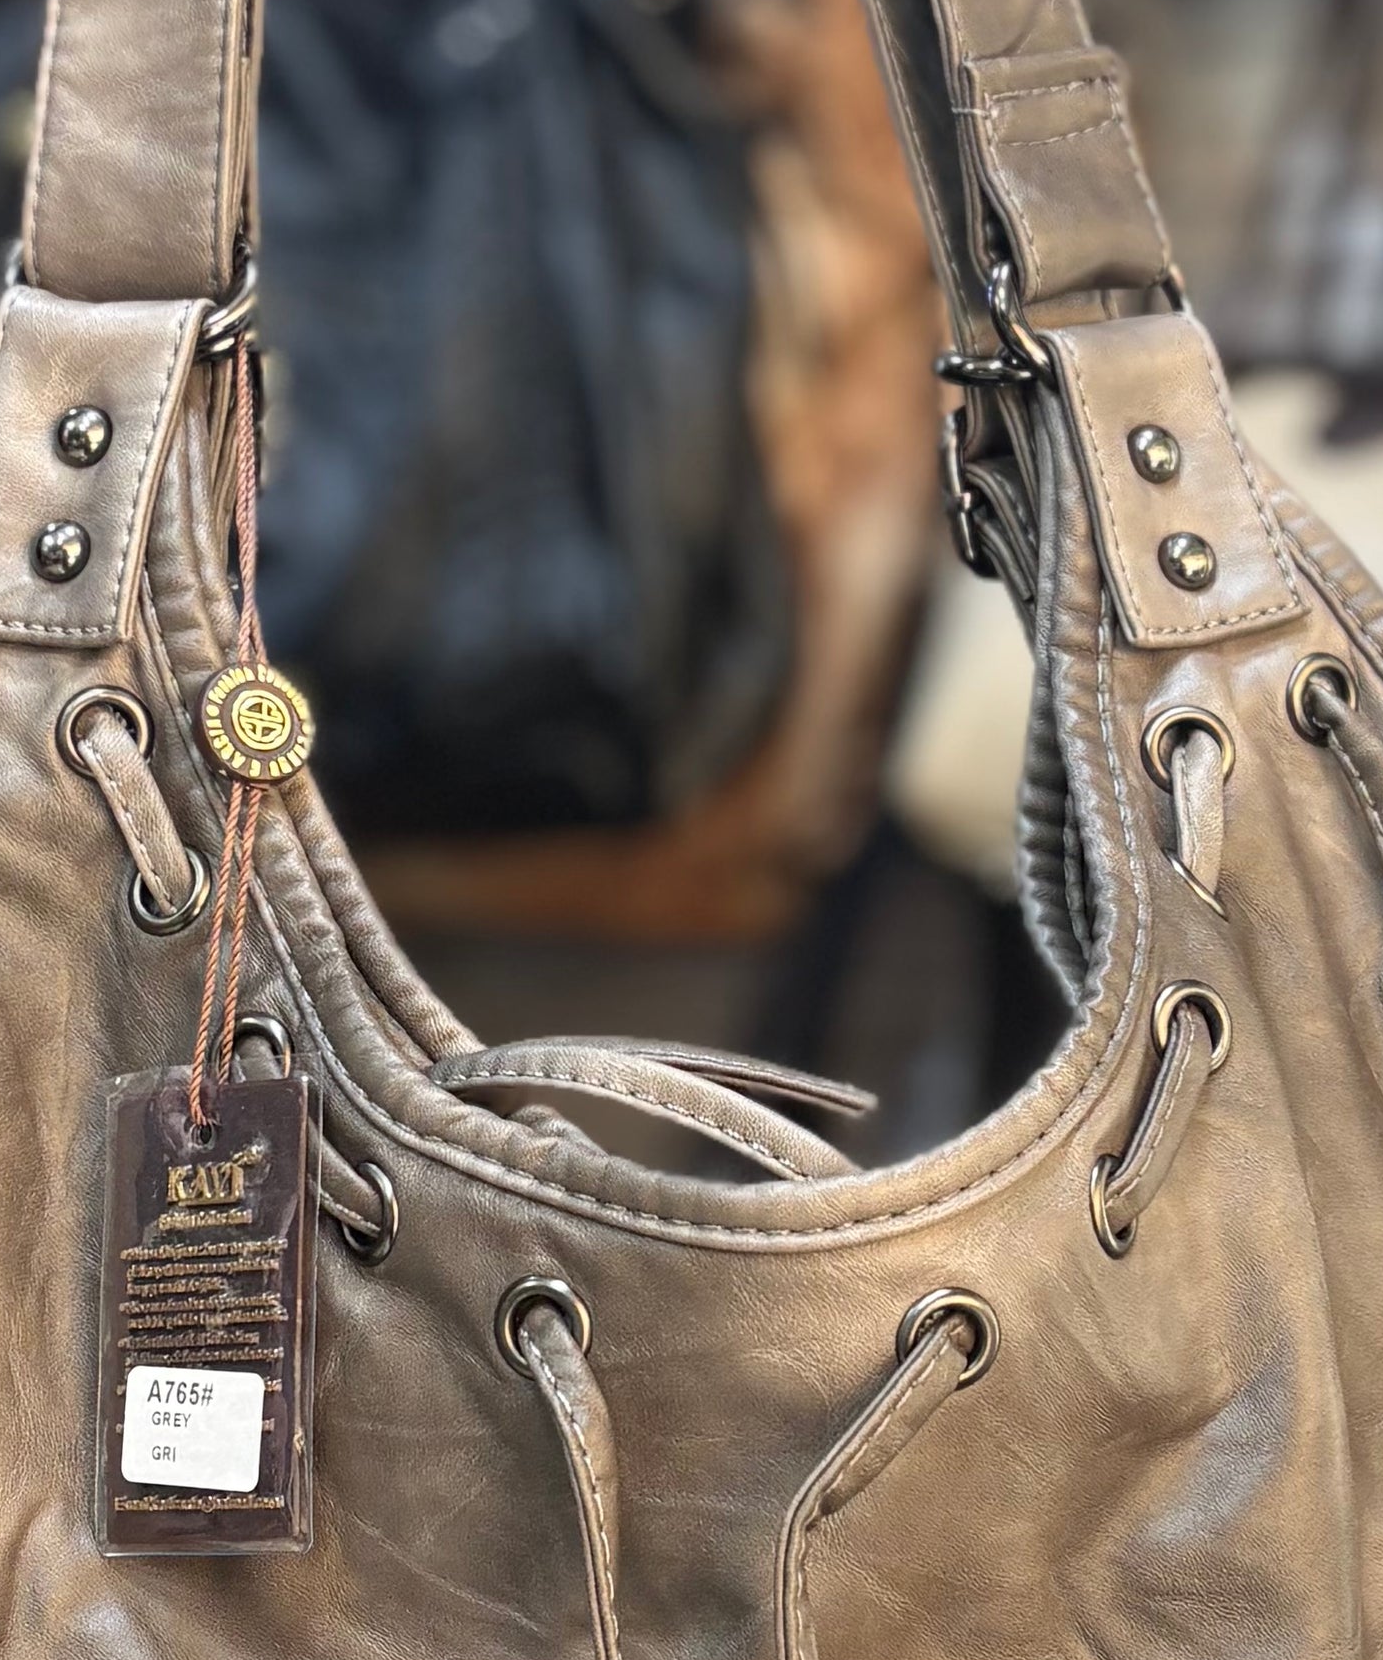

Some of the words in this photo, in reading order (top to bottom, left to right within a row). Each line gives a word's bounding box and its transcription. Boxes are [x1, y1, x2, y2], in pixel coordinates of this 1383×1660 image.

[147, 1379, 215, 1406] A765#
[151, 1411, 192, 1428] GREY
[151, 1445, 177, 1462] GRI
